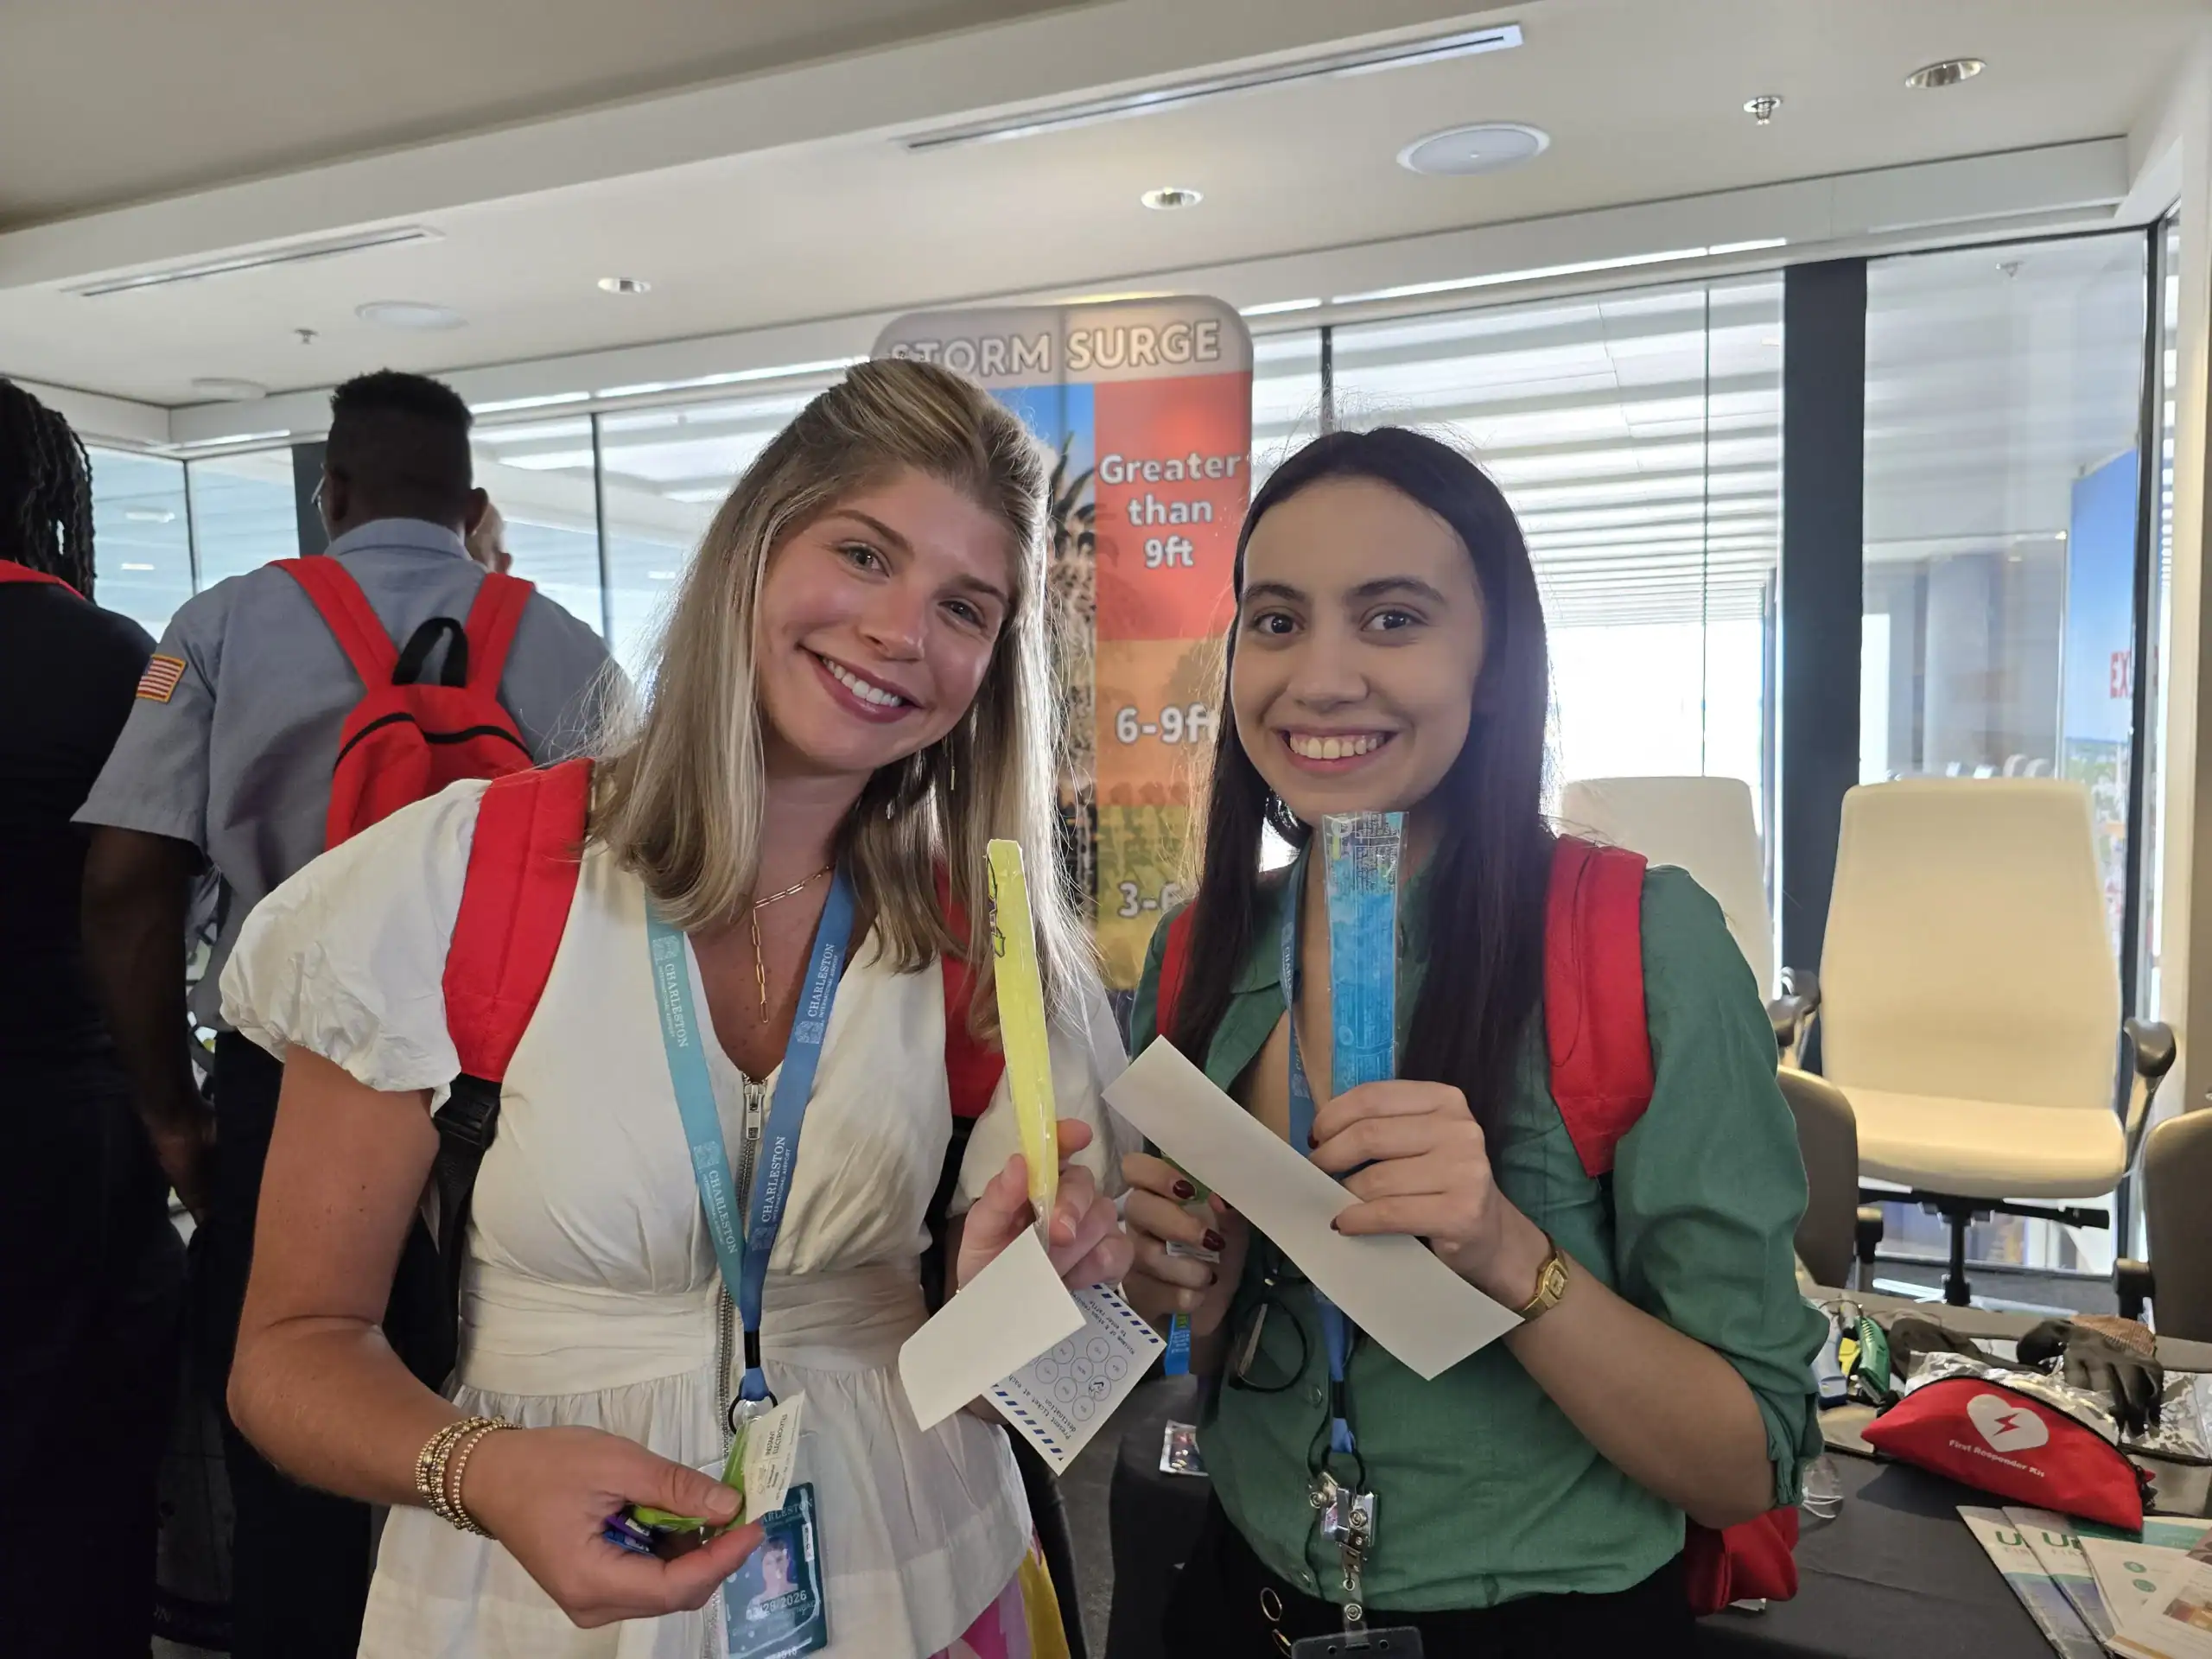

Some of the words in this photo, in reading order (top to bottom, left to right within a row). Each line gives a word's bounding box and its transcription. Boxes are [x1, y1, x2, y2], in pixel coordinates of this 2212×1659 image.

[1067, 321, 1221, 372] SURGE
[1099, 454, 1241, 485] Greater
[1128, 494, 1211, 527] than
[1145, 536, 1193, 569] 9ft
[808, 943, 836, 1018] CHARLESTON
[664, 963, 689, 1047] CHARLESTON
[761, 1135, 786, 1224] CHARLESTON
[709, 1169, 738, 1254] CHARLESTON
[1106, 1316, 1120, 1330] enter
[1007, 1374, 1022, 1389] each
[1022, 1389, 1031, 1397] at
[1030, 1396, 1051, 1417] ticket
[1049, 1416, 1072, 1440] Present
[1948, 1439, 1973, 1453] First
[1974, 1446, 2028, 1471] Responder
[2029, 1466, 2045, 1478] Kit
